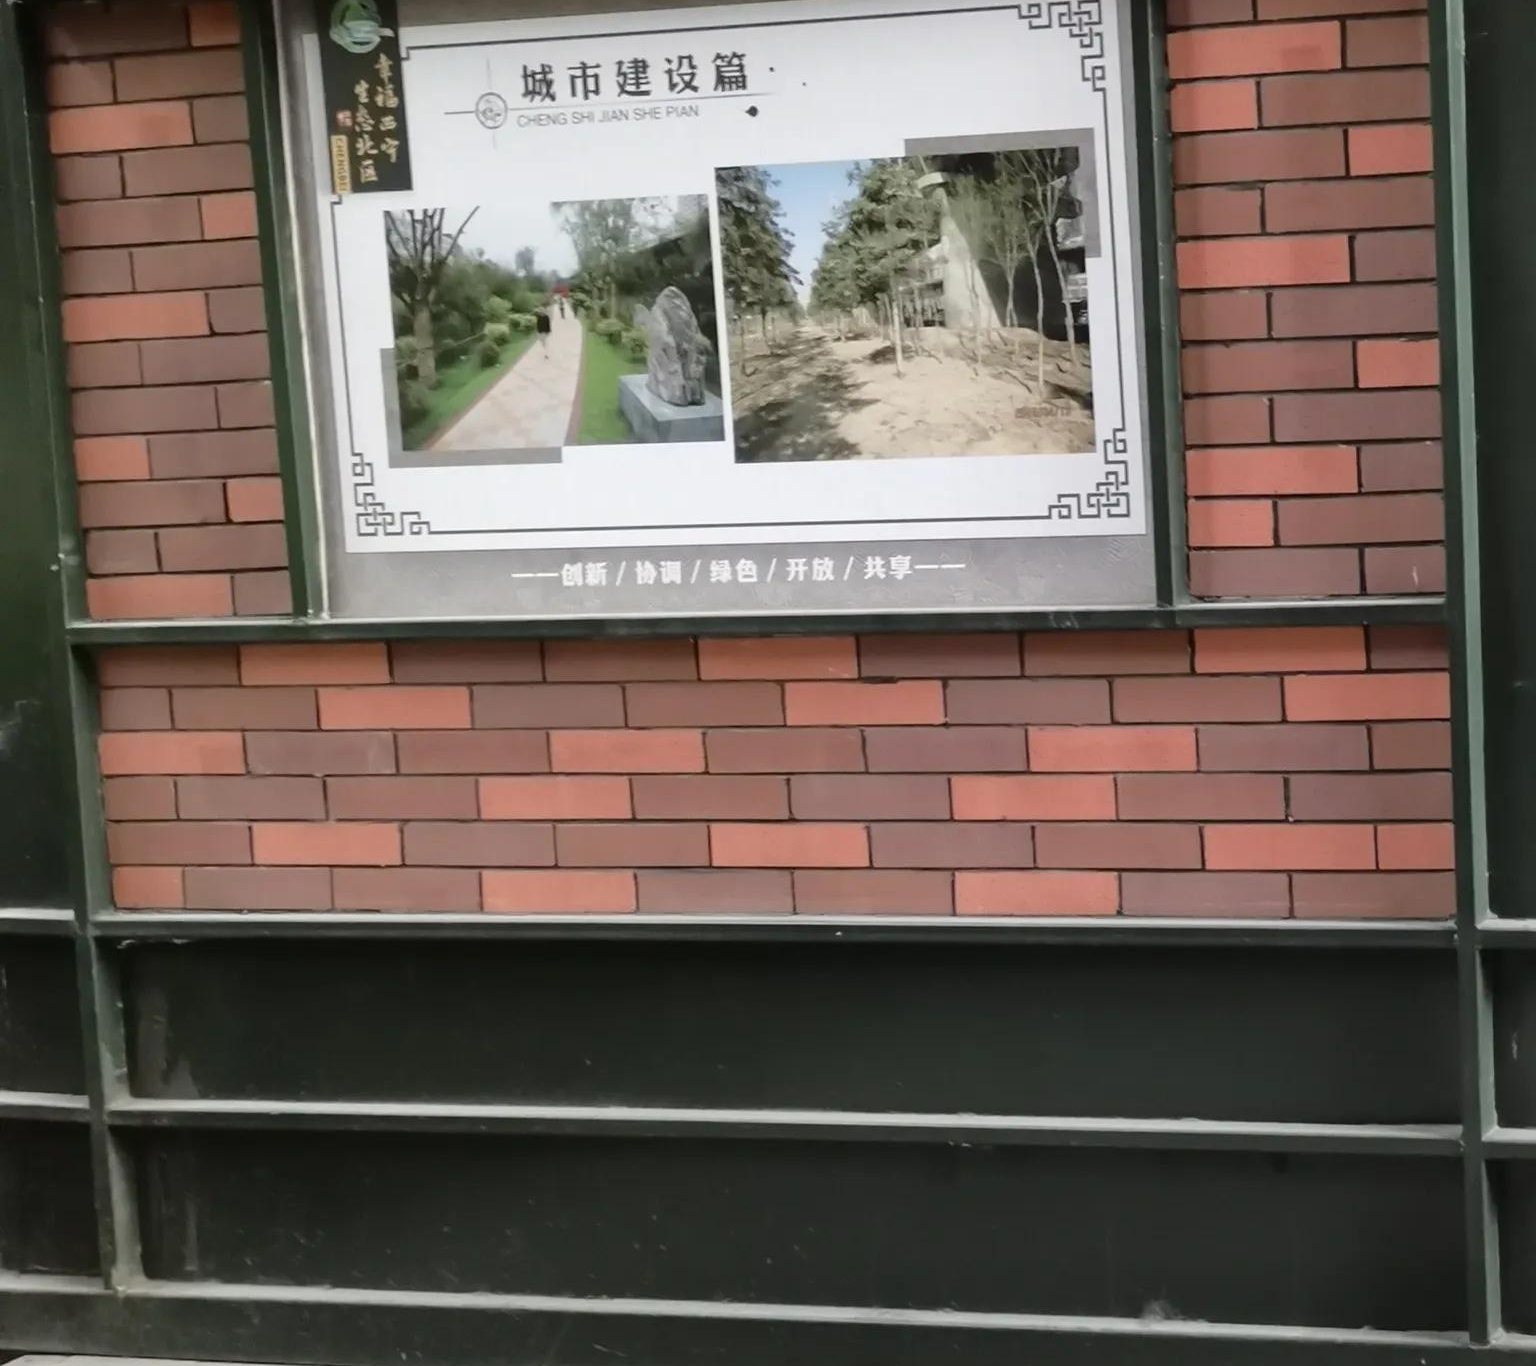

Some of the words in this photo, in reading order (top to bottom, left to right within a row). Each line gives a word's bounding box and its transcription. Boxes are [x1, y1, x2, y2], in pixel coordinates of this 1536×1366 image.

[522, 51, 748, 102] 城市建设篇
[517, 112, 567, 128] CHENG
[571, 110, 595, 125] SHI
[598, 108, 629, 123] JIAN
[633, 106, 661, 121] SHE
[666, 104, 699, 118] PIAN
